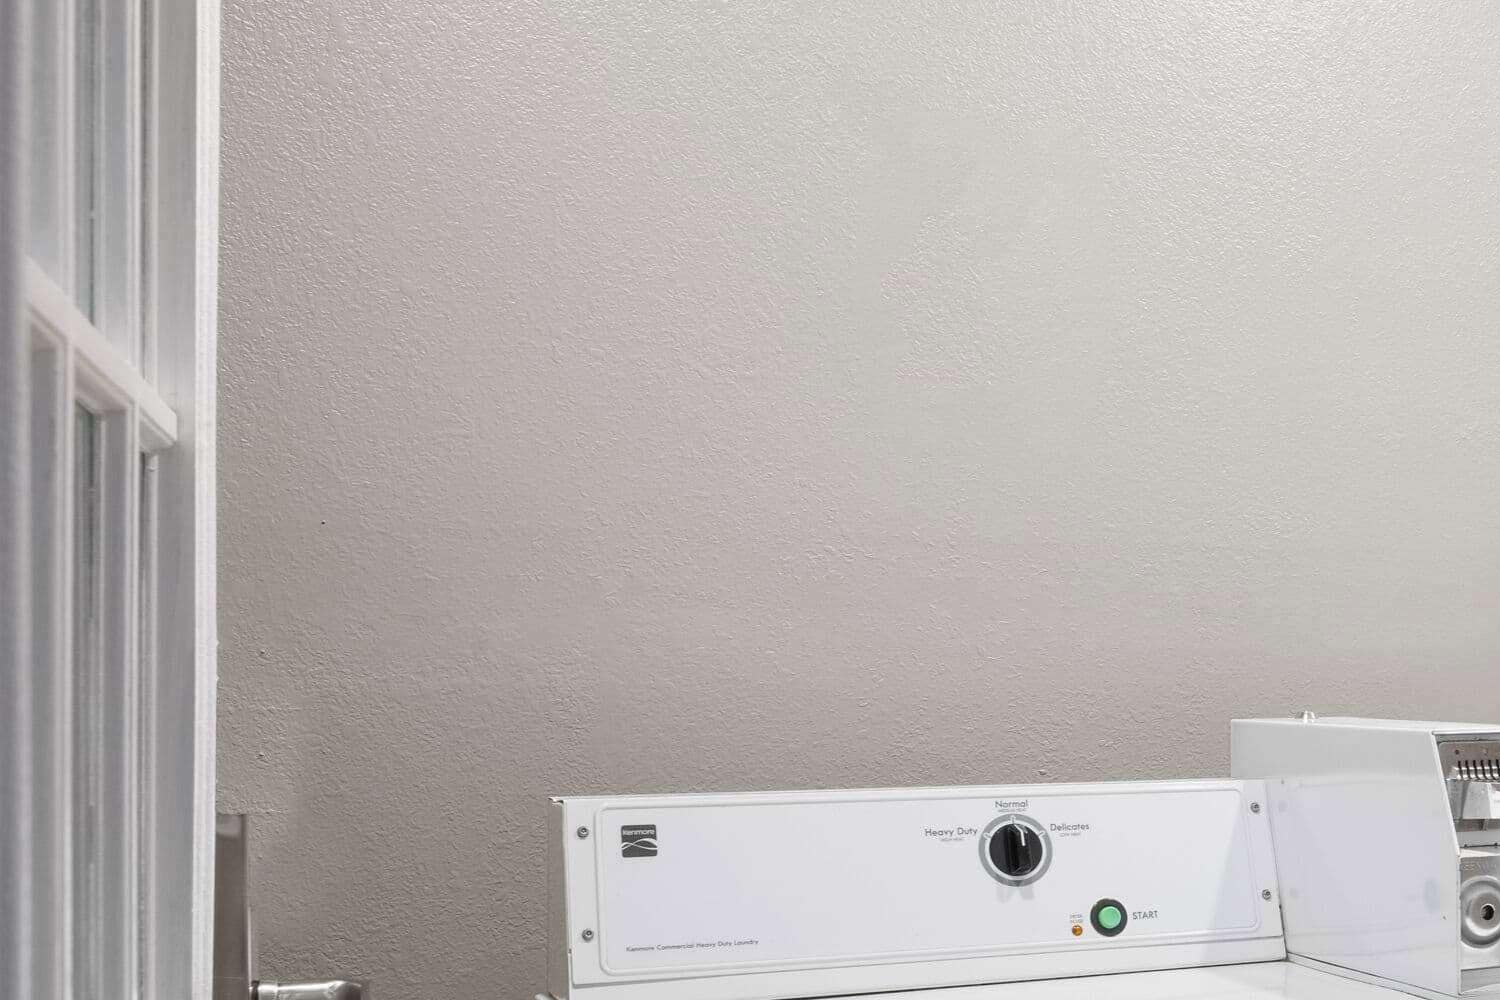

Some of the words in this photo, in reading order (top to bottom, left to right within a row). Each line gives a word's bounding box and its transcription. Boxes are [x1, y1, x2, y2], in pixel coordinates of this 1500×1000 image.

[994, 799, 1028, 808] Normal
[1050, 823, 1090, 831] Delicates
[924, 828, 955, 837] Heavy
[957, 827, 978, 836] Duty
[1132, 910, 1158, 920] START
